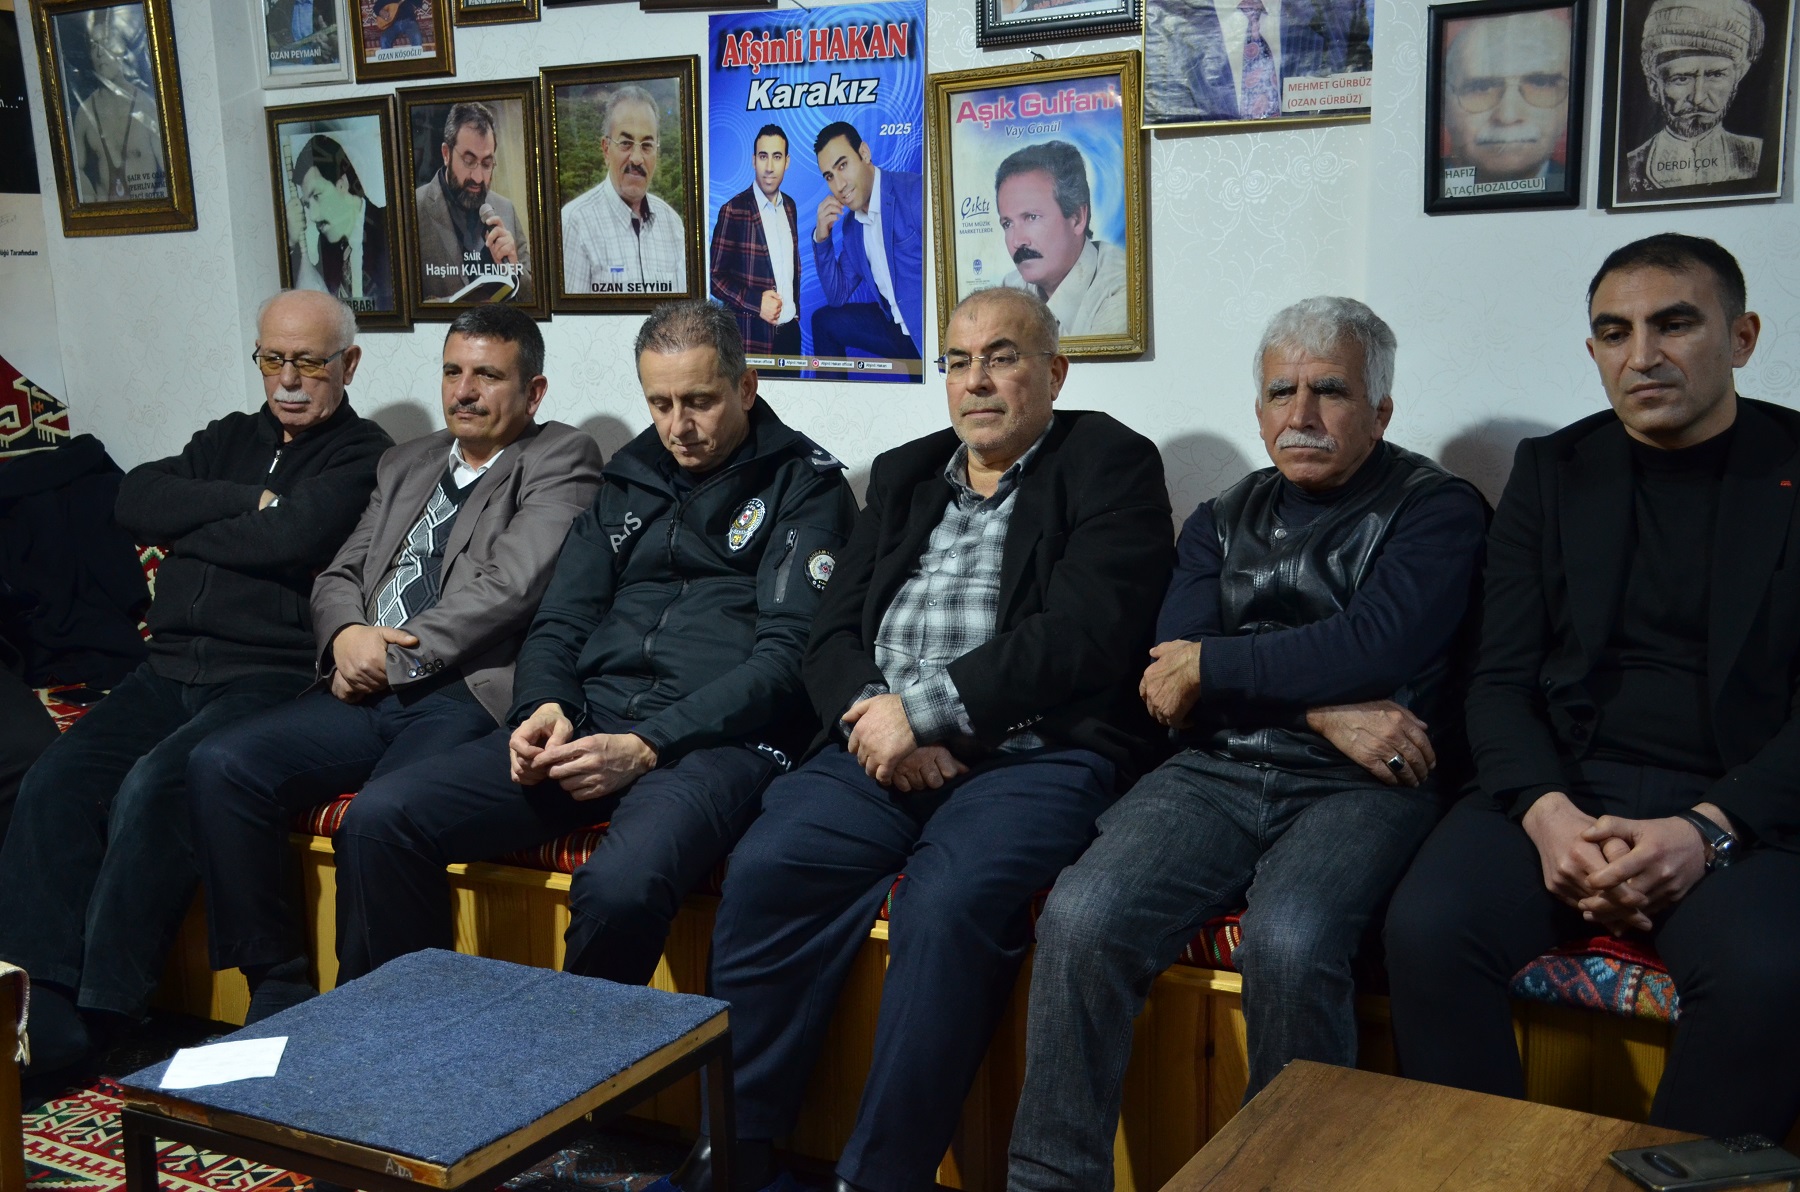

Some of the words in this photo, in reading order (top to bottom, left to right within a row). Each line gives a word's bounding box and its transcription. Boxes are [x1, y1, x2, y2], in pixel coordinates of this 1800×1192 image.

[270, 50, 290, 61] OZAN
[722, 28, 804, 74] Afşinli
[808, 22, 908, 62] HAKAN
[377, 52, 394, 61] OZAN
[746, 73, 880, 111] Karakız
[1288, 81, 1329, 92] MEHMET
[1332, 77, 1372, 89] GÜRBÜZ
[1287, 98, 1317, 109] (OZAN
[1319, 94, 1362, 106] GÜRBÜZ)
[956, 98, 1015, 129] Aşık
[879, 123, 911, 136] 2025
[1005, 124, 1024, 139] Vay
[1027, 121, 1061, 135] Gönül
[1657, 157, 1691, 171] DERDİ
[1694, 157, 1718, 170] ÇOK
[142, 172, 150, 180] VE
[1445, 168, 1475, 179] HAFIZ
[961, 196, 991, 220] Çıktı
[425, 263, 459, 278] Haşim
[461, 263, 524, 276] KALENDER
[591, 282, 623, 293] OZAN
[627, 280, 673, 293] SEYYİDİ
